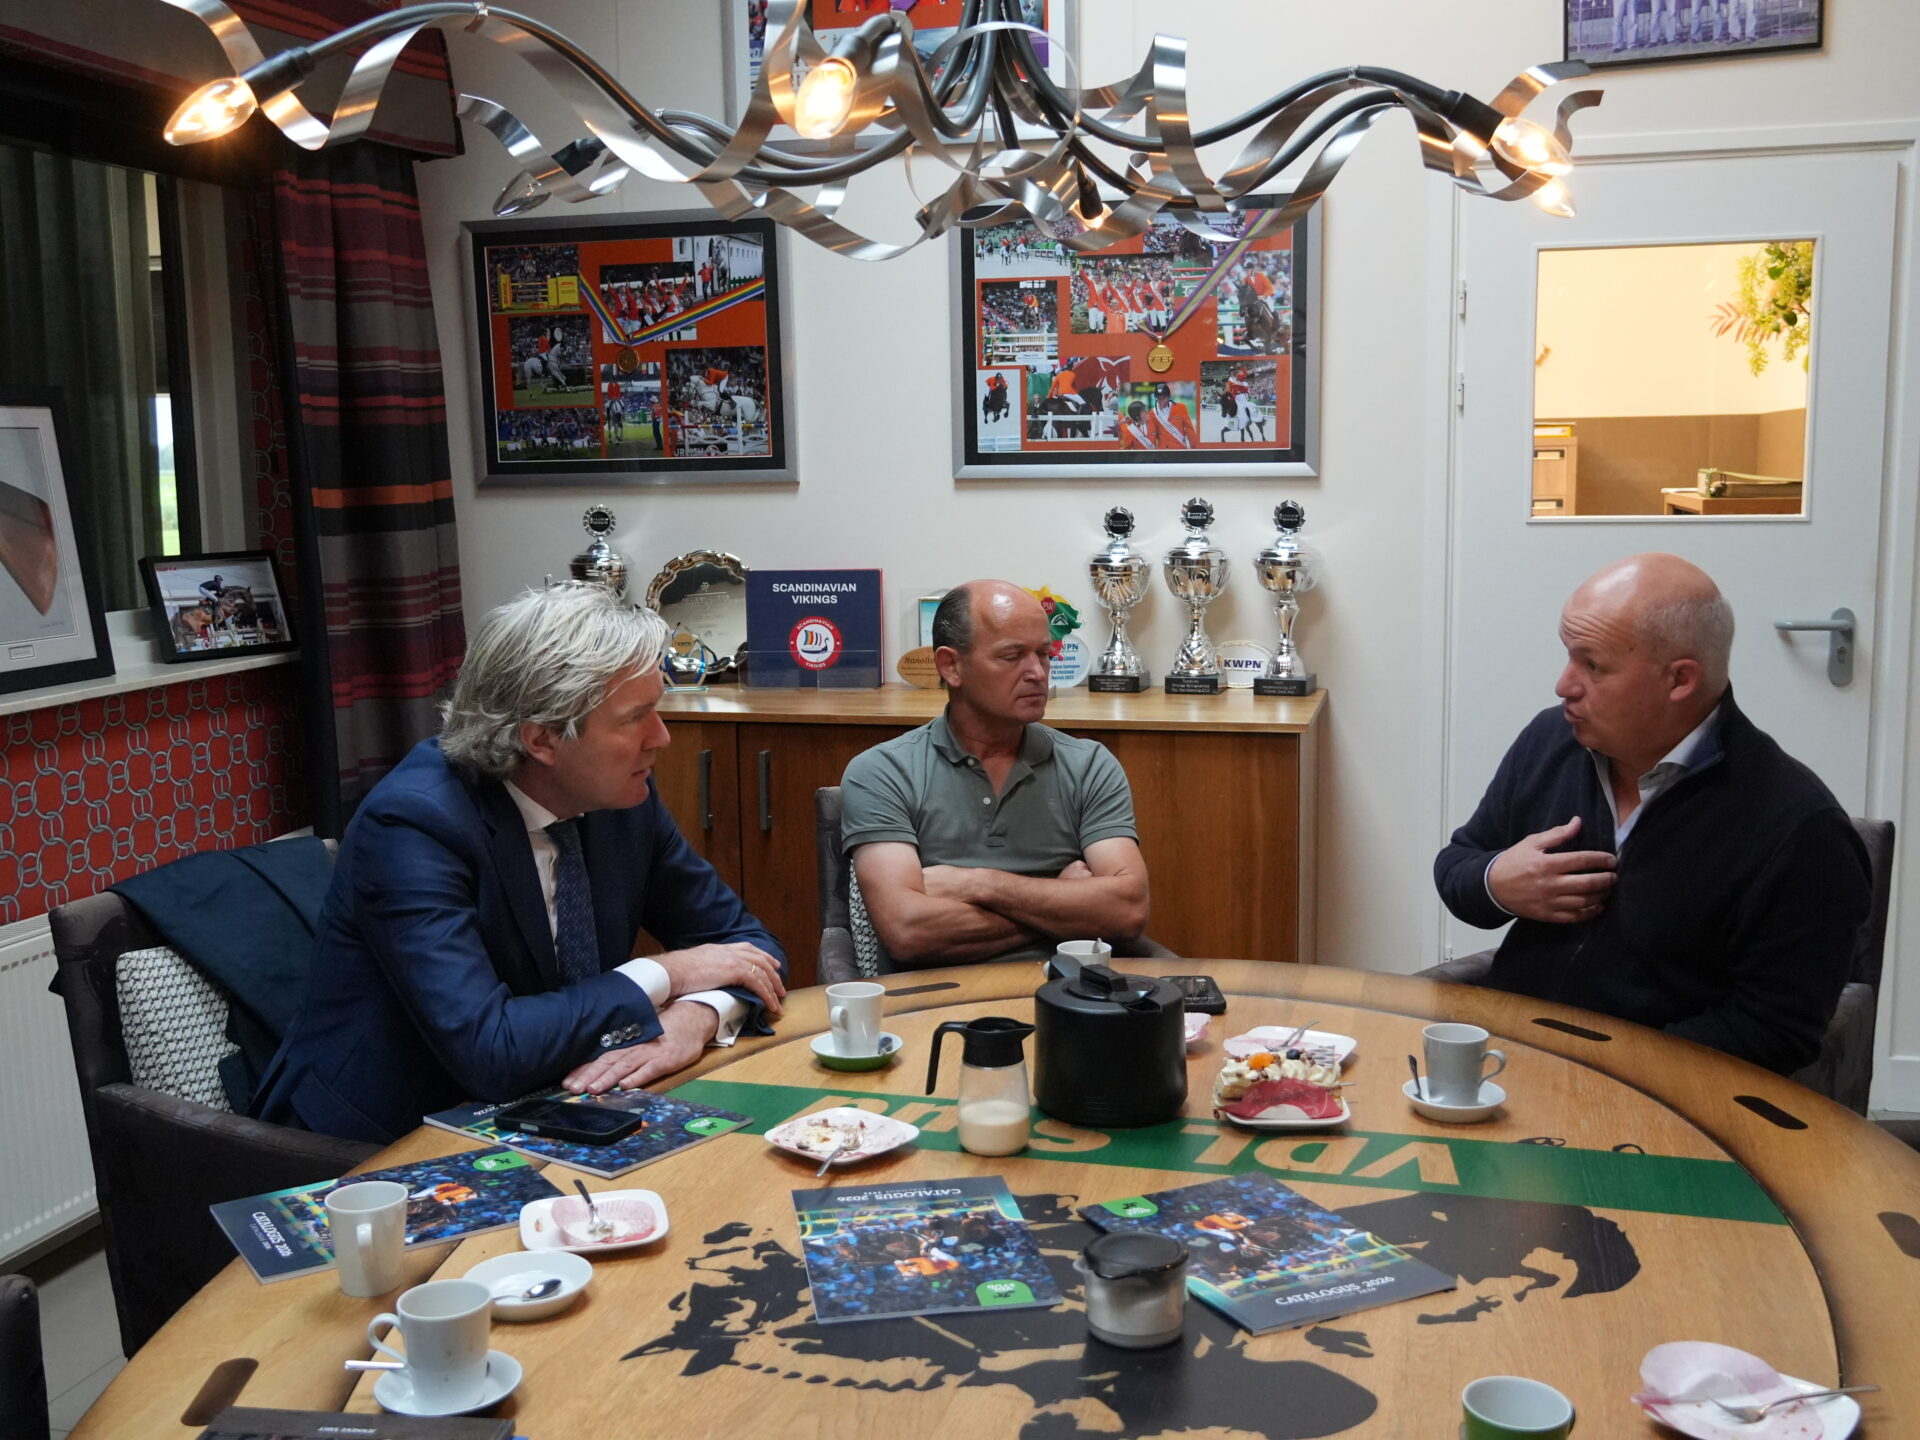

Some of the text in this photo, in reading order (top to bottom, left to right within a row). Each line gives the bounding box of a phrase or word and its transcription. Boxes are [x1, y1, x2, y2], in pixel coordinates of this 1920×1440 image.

[772, 583, 857, 592] SCANDINAVIAN
[791, 595, 838, 604] VIKINGS
[796, 618, 834, 630] SCANDINAVIAN
[1223, 659, 1261, 669] KWPN
[1177, 1123, 1462, 1186] VDL
[837, 1187, 962, 1202] CATALOGUS 2026
[252, 1211, 293, 1257] CATALOGUS 2026
[1275, 1276, 1395, 1305] CATALOGUS 2026
